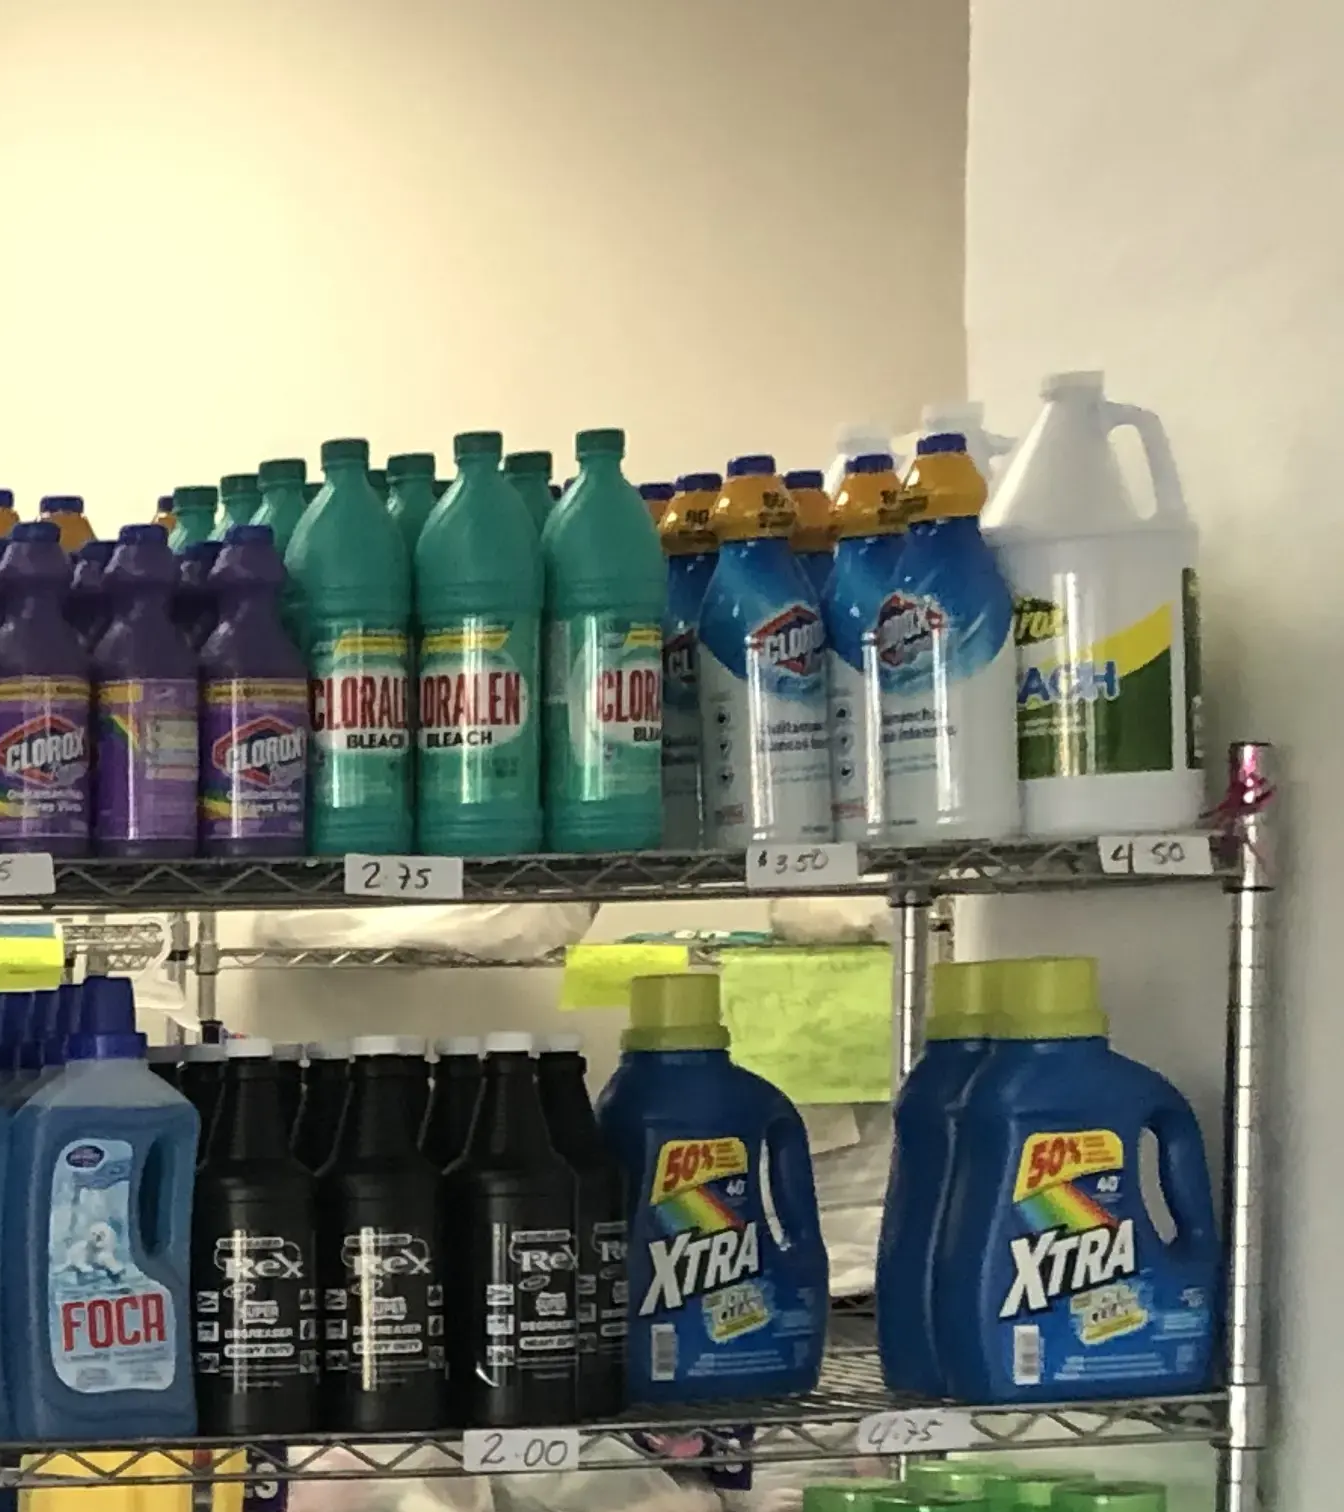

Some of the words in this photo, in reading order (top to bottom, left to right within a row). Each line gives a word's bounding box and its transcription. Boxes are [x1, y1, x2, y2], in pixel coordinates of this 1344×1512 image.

[5, 727, 86, 773] CLOROX
[638, 1222, 760, 1317] XTRA
[998, 1221, 1138, 1320] XTRA
[61, 1292, 168, 1353] FOCA
